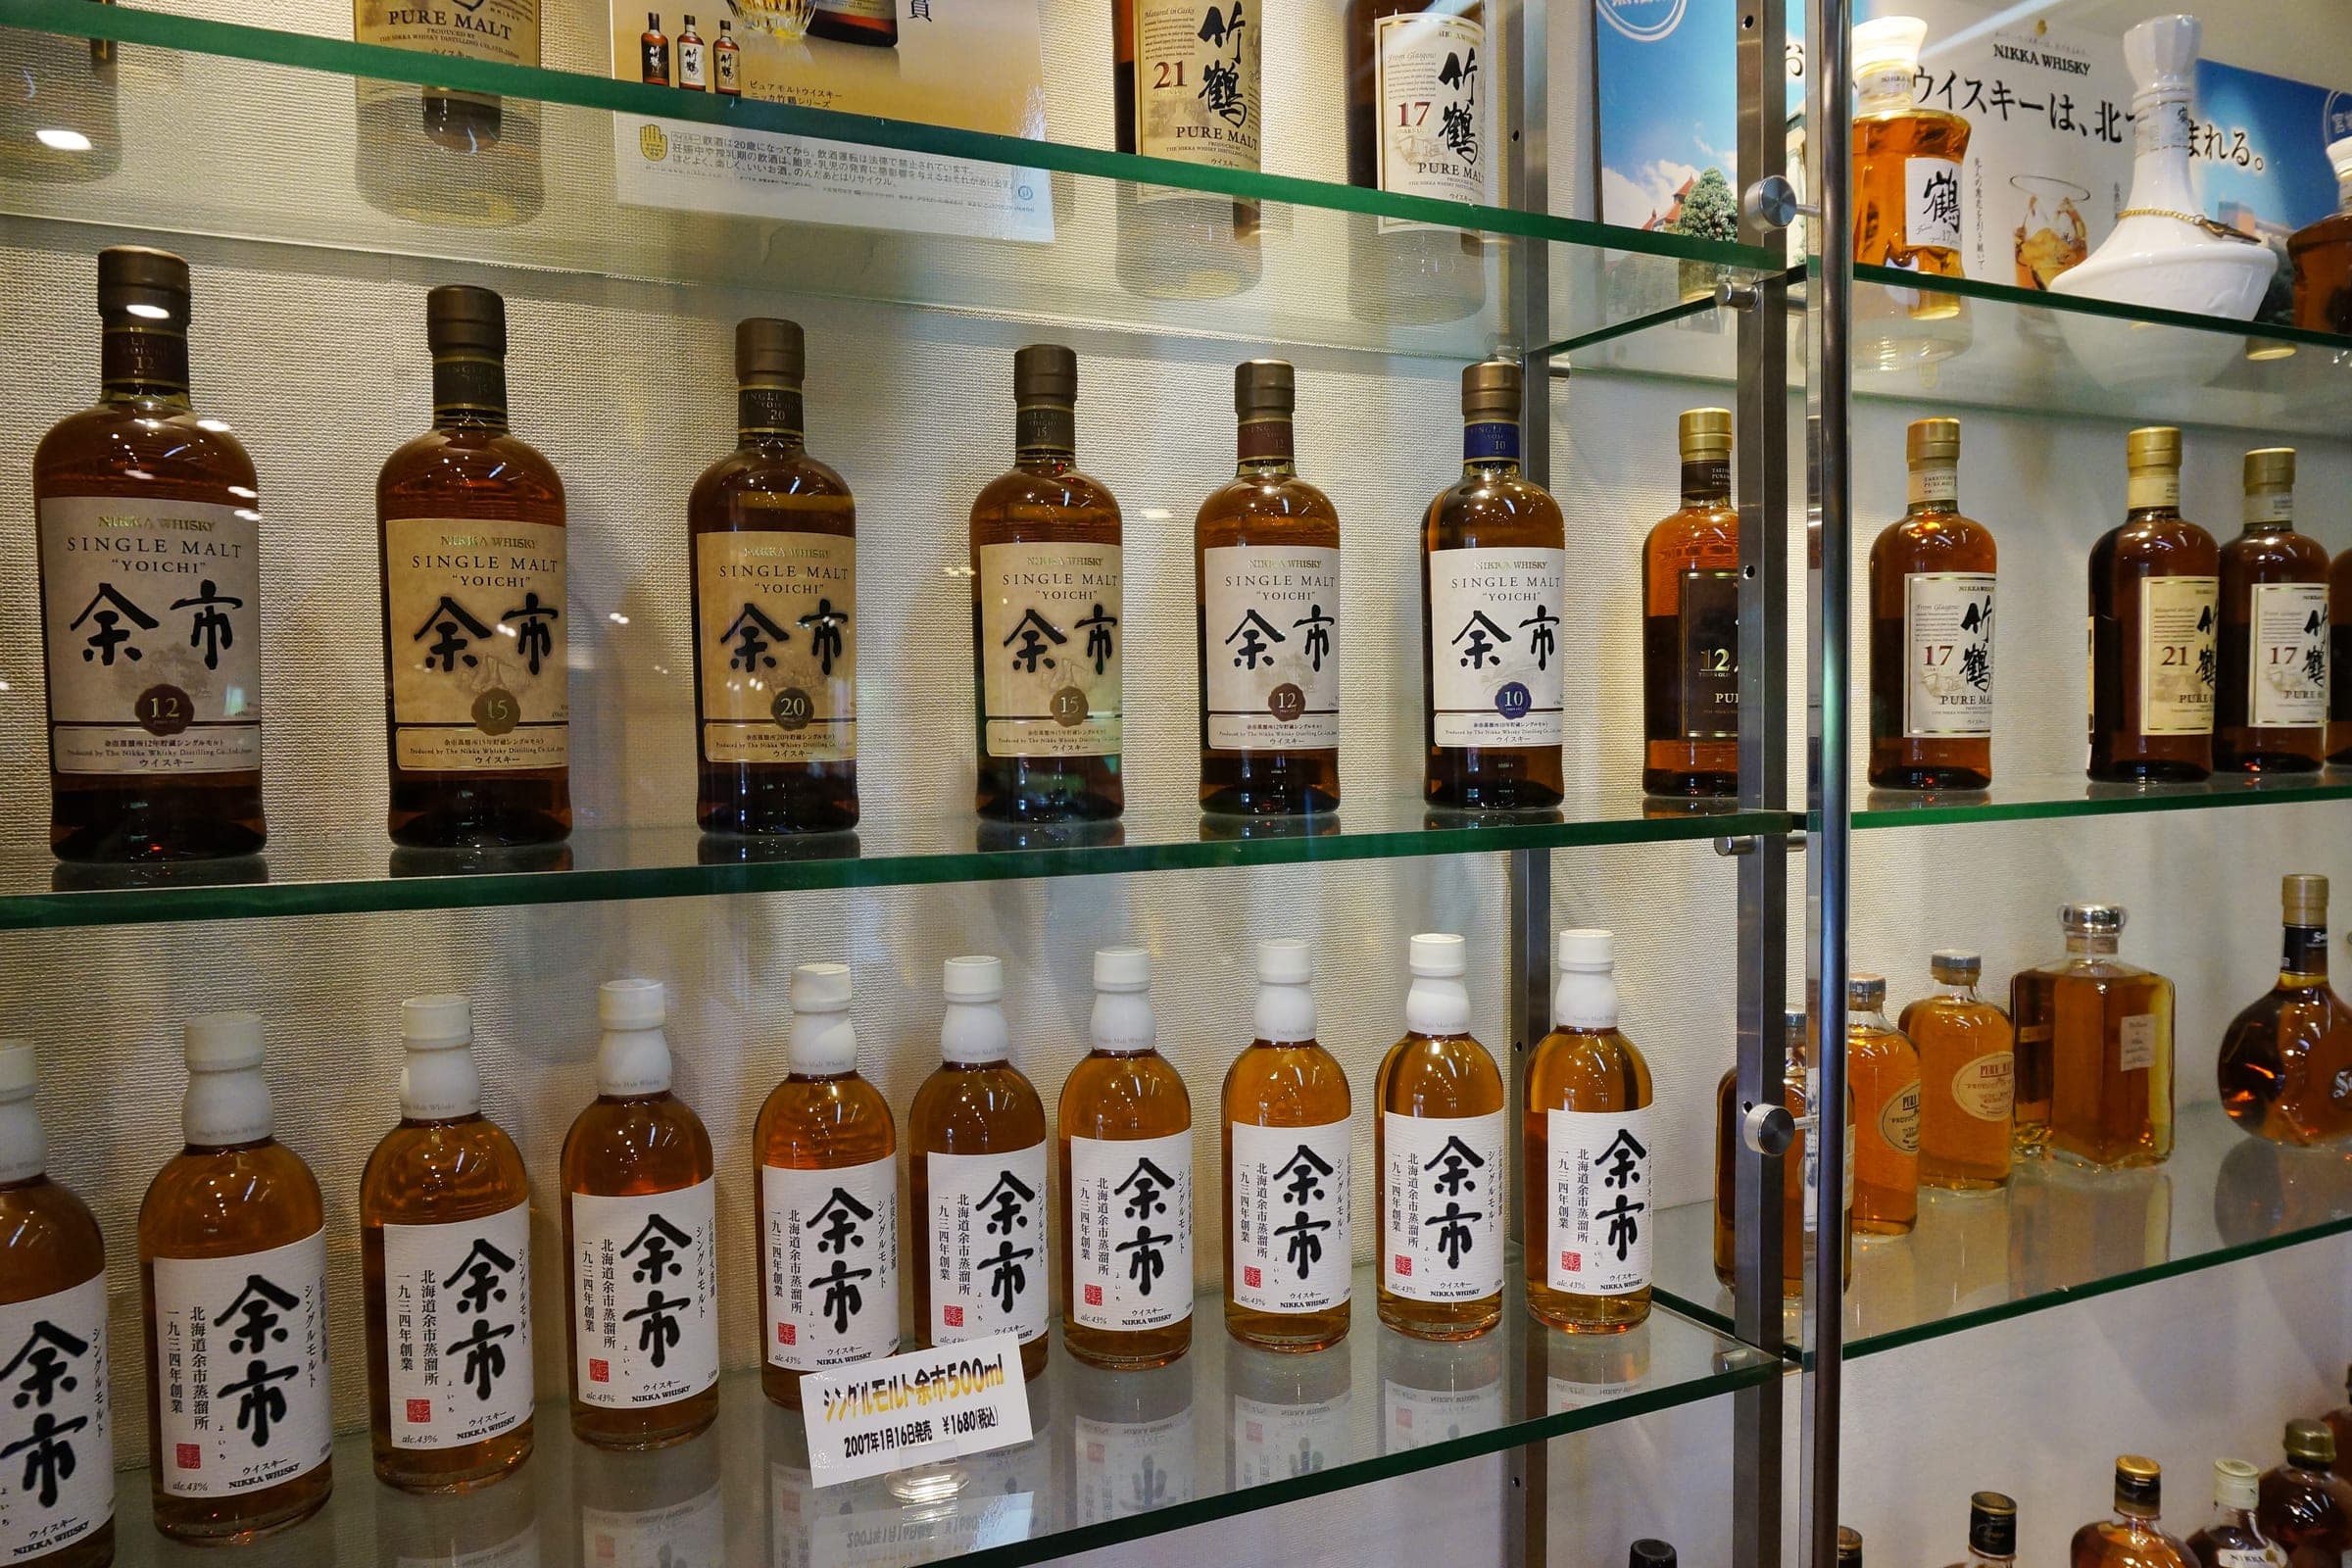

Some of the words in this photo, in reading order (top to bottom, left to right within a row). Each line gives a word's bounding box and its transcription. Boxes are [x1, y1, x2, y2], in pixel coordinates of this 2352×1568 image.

[388, 10, 447, 25] PURE
[455, 14, 512, 40] MALT
[1152, 61, 1188, 89] 21
[1198, 1, 1247, 128] 竹鶴
[1993, 44, 2039, 66] NIKKA
[2042, 56, 2091, 75] WHISKY
[1397, 102, 1431, 127] 17
[1438, 47, 1478, 165] 竹鶴
[1176, 126, 1223, 139] PURE
[1228, 130, 1257, 151] MALT
[1418, 162, 1460, 174] PURE
[159, 517, 216, 532] WHISKY
[67, 537, 167, 554] SINGLE
[181, 541, 242, 559] MALT
[492, 537, 537, 549] WHISKY
[413, 556, 499, 569] SINGLE
[511, 557, 558, 573] MALT
[719, 565, 796, 577] SINGLE
[808, 567, 849, 580] MALT
[1004, 574, 1073, 585] SINGLE
[1082, 574, 1117, 586] MALT
[1225, 575, 1293, 586] SINGLE
[1301, 576, 1335, 588] MALT
[1451, 577, 1518, 588] SINGLE
[70, 579, 243, 670] 余市
[414, 592, 559, 675] 余市
[720, 599, 849, 675] 余市
[1004, 604, 1118, 675] 余市
[1225, 604, 1335, 672] 余市
[1451, 604, 1559, 671] 余市
[1700, 648, 1730, 672] 12
[1923, 645, 1953, 666] 17
[2161, 646, 2189, 666] 21
[2270, 647, 2298, 665] 17
[151, 697, 179, 718] 12
[488, 700, 509, 720] 15
[780, 697, 806, 715] 20
[1060, 696, 1079, 714] 15
[1278, 693, 1297, 709] 12
[1504, 691, 1523, 708] 10
[1941, 696, 1976, 706] PURE
[139, 759, 193, 767] ウイスキー
[475, 756, 519, 764] ウイスキー
[1240, 1163, 1250, 1243] 一九三四年創業
[1392, 1152, 1401, 1232] 一九三四年創業
[1407, 1152, 1419, 1248] 北海道余市蒸溜所
[1424, 1136, 1485, 1269] 余市
[1558, 1150, 1569, 1229] 一九三四年創業
[1577, 1149, 1590, 1244] 北海道余市蒸溜所
[1594, 1129, 1646, 1261] 余市
[1080, 1179, 1091, 1260] 一九三四年創業
[1114, 1157, 1175, 1296] 余市
[1256, 1162, 1268, 1258] 北海道余市蒸溜所
[1273, 1145, 1334, 1280] 余市
[938, 1196, 951, 1281] 一九三四年創業
[975, 1170, 1035, 1313] 余市
[1098, 1178, 1109, 1276] 北海道余市蒸溜所
[771, 1211, 783, 1298] 一九三四年創業
[789, 1209, 803, 1314] 北海道余市蒸溜所
[807, 1188, 873, 1333] 余市
[956, 1194, 971, 1296] 北海道余市蒸溜所
[582, 1242, 595, 1332] 一九三四年創業
[601, 1239, 616, 1348] 北海道余市蒸溜所
[620, 1214, 692, 1367] 余市
[1455, 1288, 1480, 1297] WHISKY
[1609, 1273, 1637, 1282] ウイスキー
[1624, 1278, 1643, 1289] WHISKY
[398, 1275, 413, 1371] 一九三四年創業
[443, 1239, 515, 1400] 余市
[1132, 1307, 1164, 1316] ウイスキー
[305, 1285, 316, 1389] シングルモルト
[420, 1270, 439, 1387] 北海道余市蒸溜所
[167, 1311, 183, 1413] 一九三四年創業
[214, 1274, 300, 1447] 余市
[827, 1347, 862, 1355] ウイスキー
[844, 1351, 872, 1363] WHISKY
[190, 1306, 209, 1431] 北海道余市蒸溜所
[632, 1392, 661, 1402] NIKKA
[662, 1385, 691, 1398] WHISKY
[644, 1380, 680, 1392] ウイスキー
[824, 1353, 1004, 1421] シングルモルト余市500ml
[0, 1320, 88, 1508] 余市
[457, 1426, 487, 1440] NIKKA
[487, 1415, 516, 1431] WHISKY
[468, 1410, 507, 1425] ウイスキー
[844, 1420, 933, 1458] 2007年1月16日発売
[228, 1475, 264, 1489] NIKKA
[265, 1462, 300, 1482] WHISKY
[242, 1458, 288, 1474] ウイスキー
[13, 1539, 53, 1556] NIKKA
[54, 1521, 89, 1543] WHISKY
[29, 1516, 77, 1539] ウイスキー
